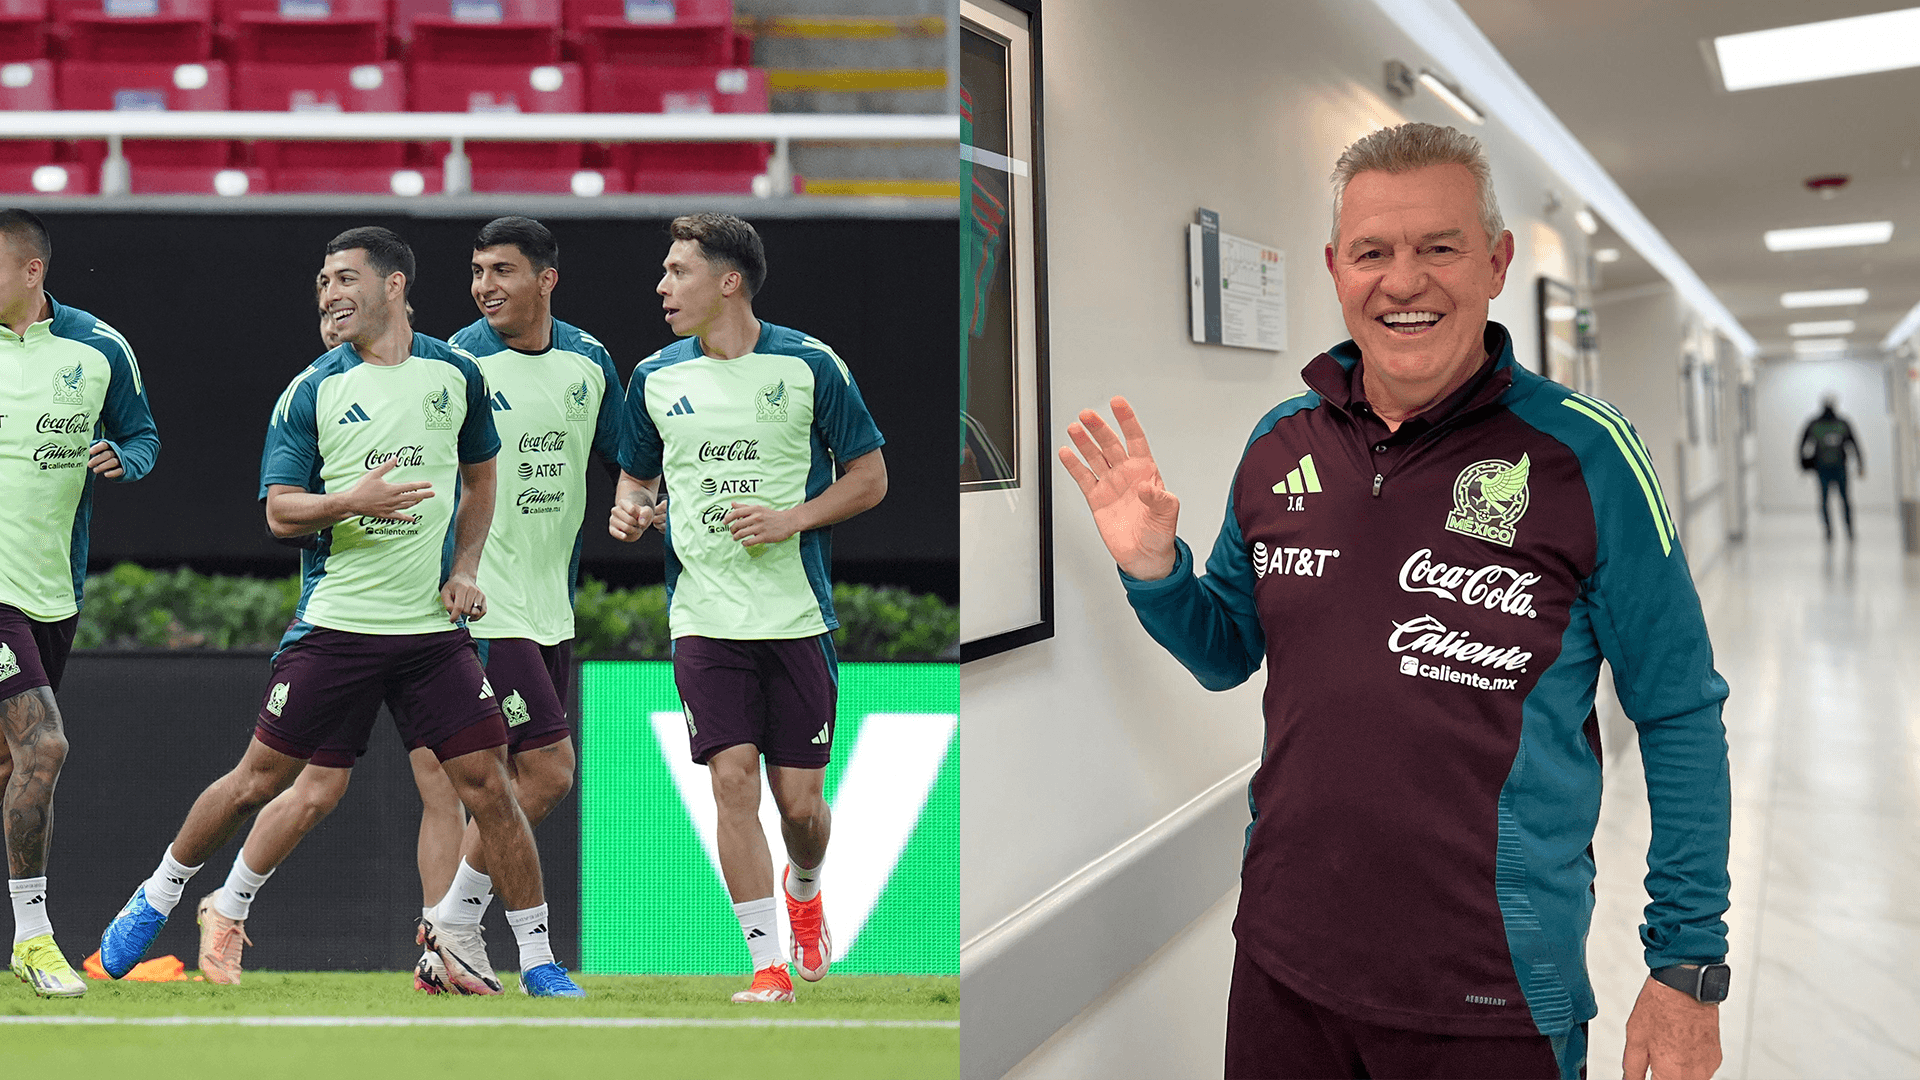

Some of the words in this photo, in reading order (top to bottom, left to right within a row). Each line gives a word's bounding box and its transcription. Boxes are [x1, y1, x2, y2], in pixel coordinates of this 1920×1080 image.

[36, 413, 90, 434] Coca-Cola
[519, 431, 568, 453] Coca-Cola
[699, 439, 759, 462] Coca-Cola
[535, 463, 564, 477] AT&T
[720, 479, 760, 494] AT&T
[1287, 495, 1305, 511] J.A.
[1268, 547, 1333, 577] AT&T
[1399, 548, 1541, 618] Coca-Cola
[1388, 614, 1533, 673] Caliente
[1419, 664, 1518, 690] caliente.mx
